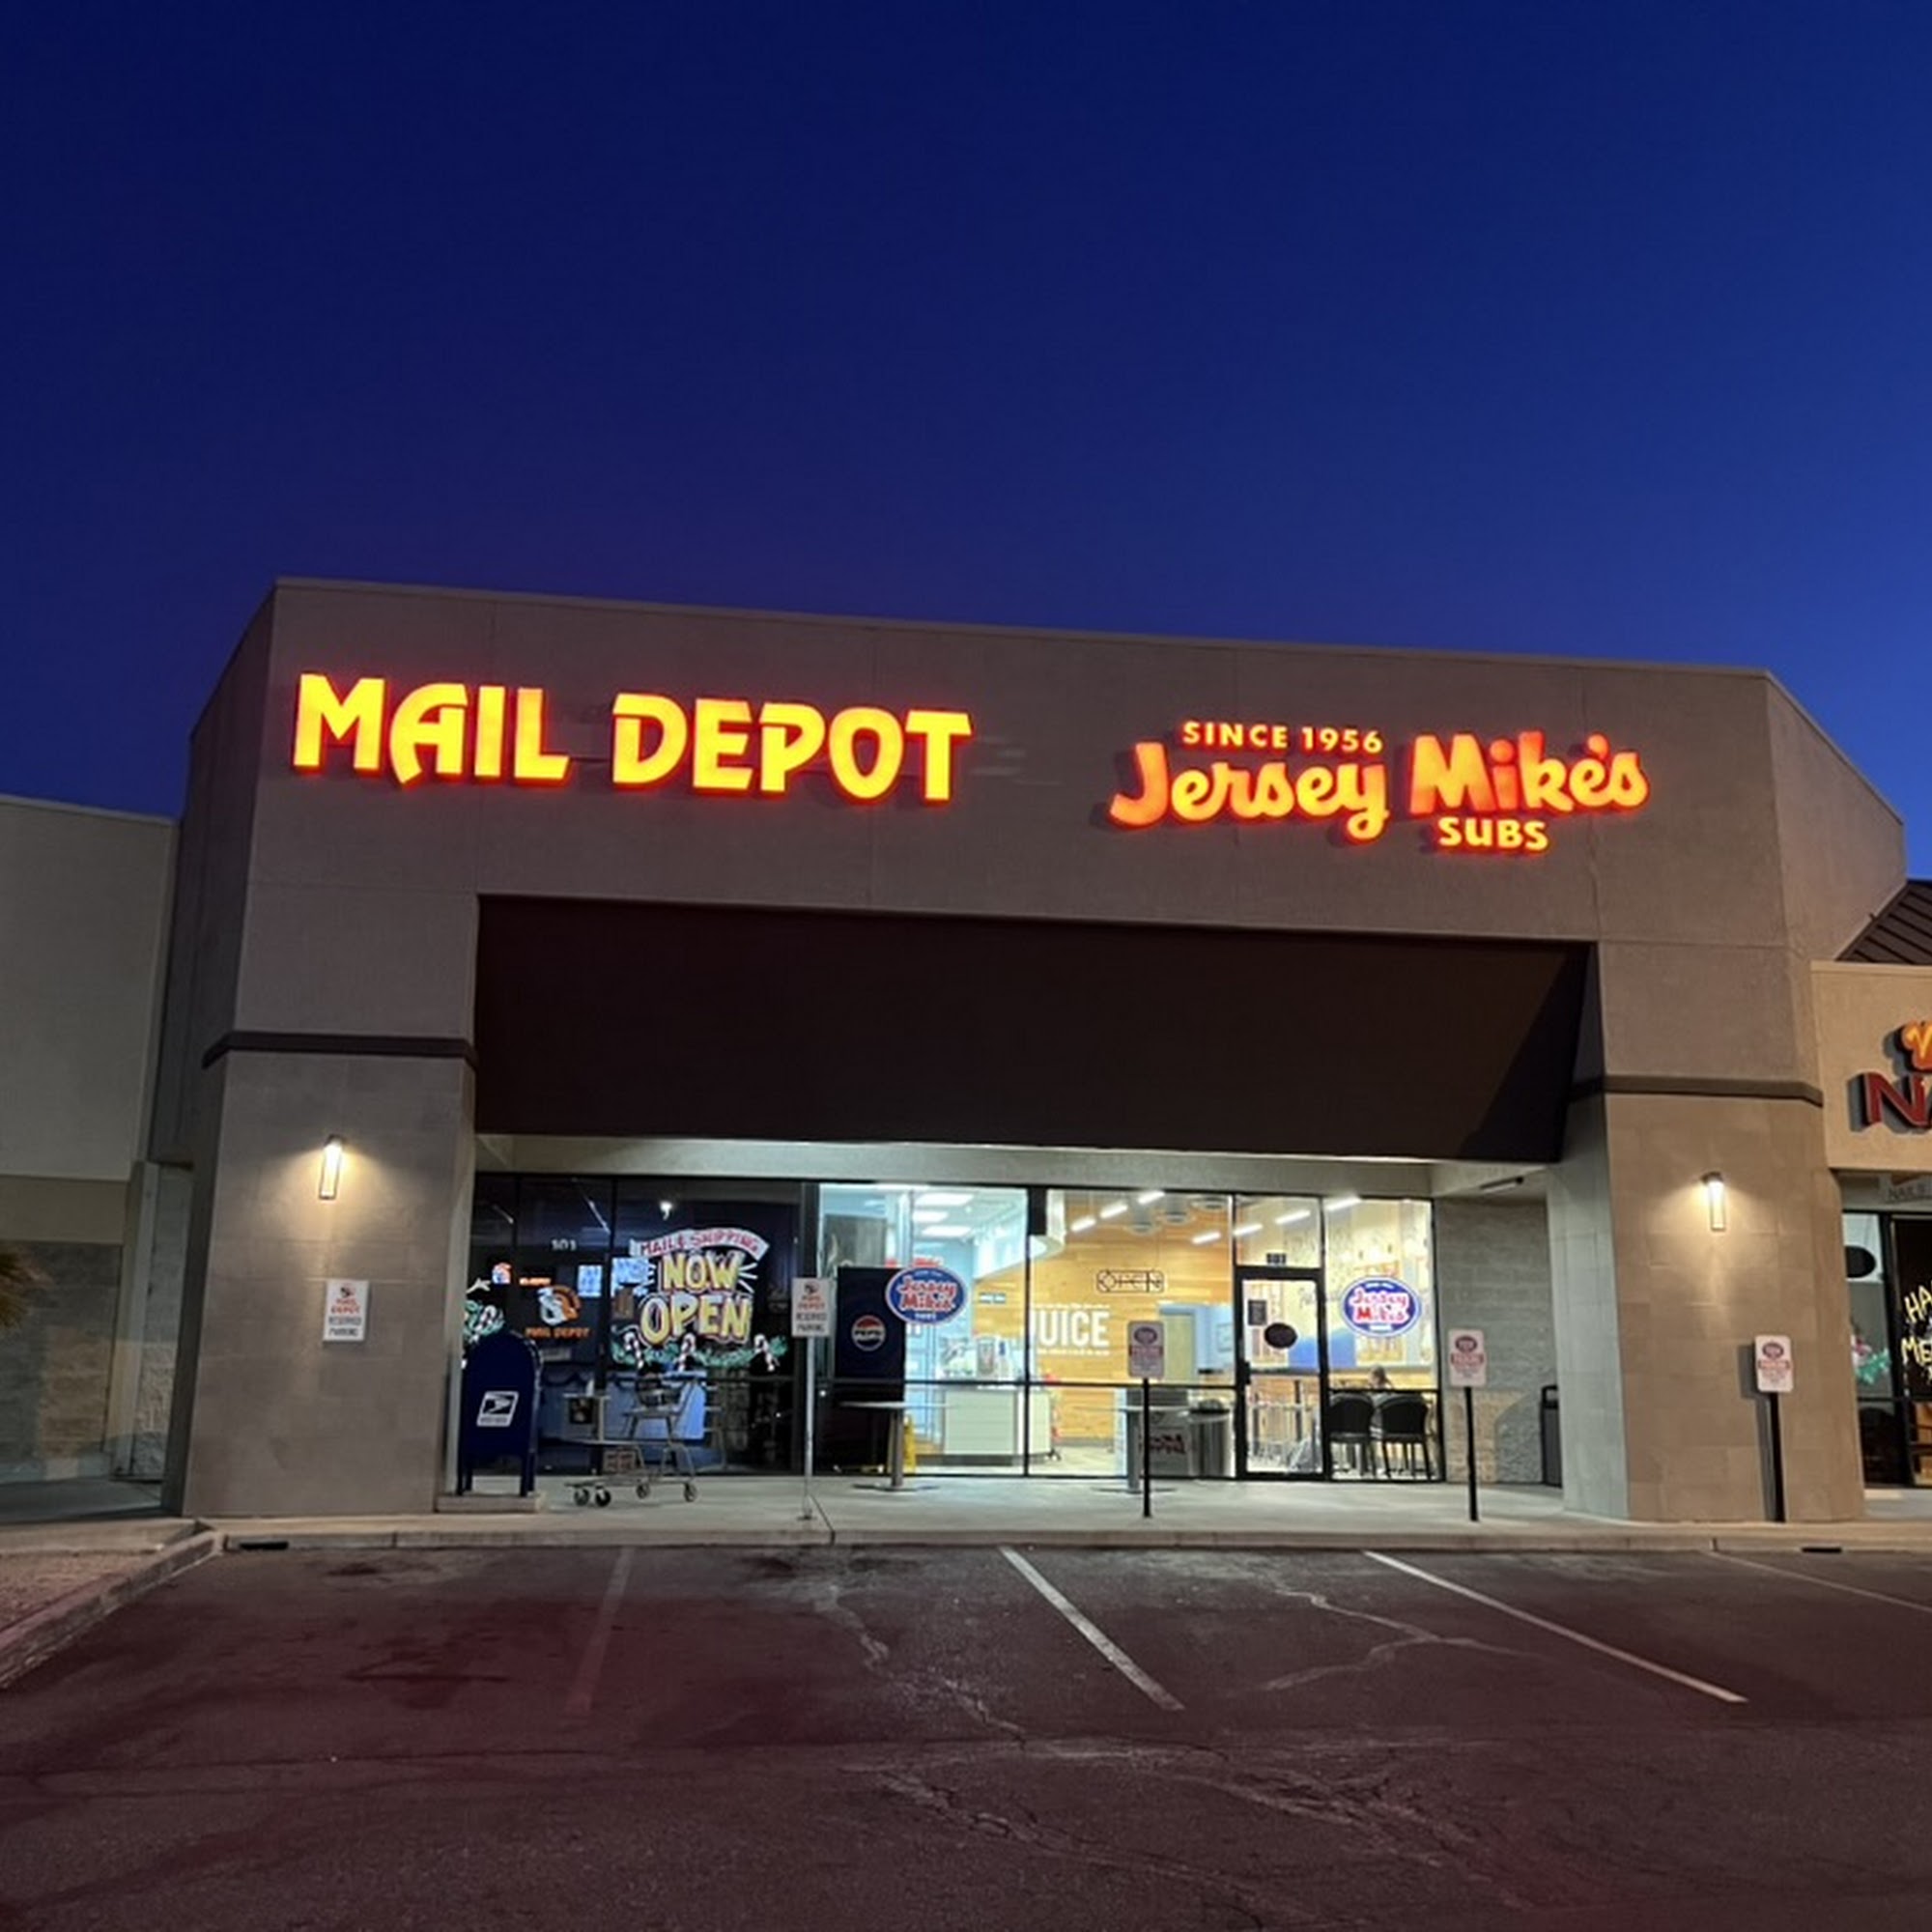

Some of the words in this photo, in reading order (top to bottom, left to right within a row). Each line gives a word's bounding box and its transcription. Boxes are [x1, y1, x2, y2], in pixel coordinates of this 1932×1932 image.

[293, 673, 571, 783] MAIL
[612, 693, 972, 801] DEPOT
[1182, 721, 1289, 749] SINCE
[1301, 726, 1382, 754] 1956
[1110, 742, 1389, 840] Jersey
[1409, 730, 1649, 814] Mike's
[1437, 817, 1548, 851] SUBS
[1863, 1070, 1932, 1127] N
[640, 1237, 675, 1255] MAIL
[693, 1229, 760, 1253] SHIPPING
[662, 1250, 746, 1292] NOW
[640, 1293, 752, 1345] OPEN
